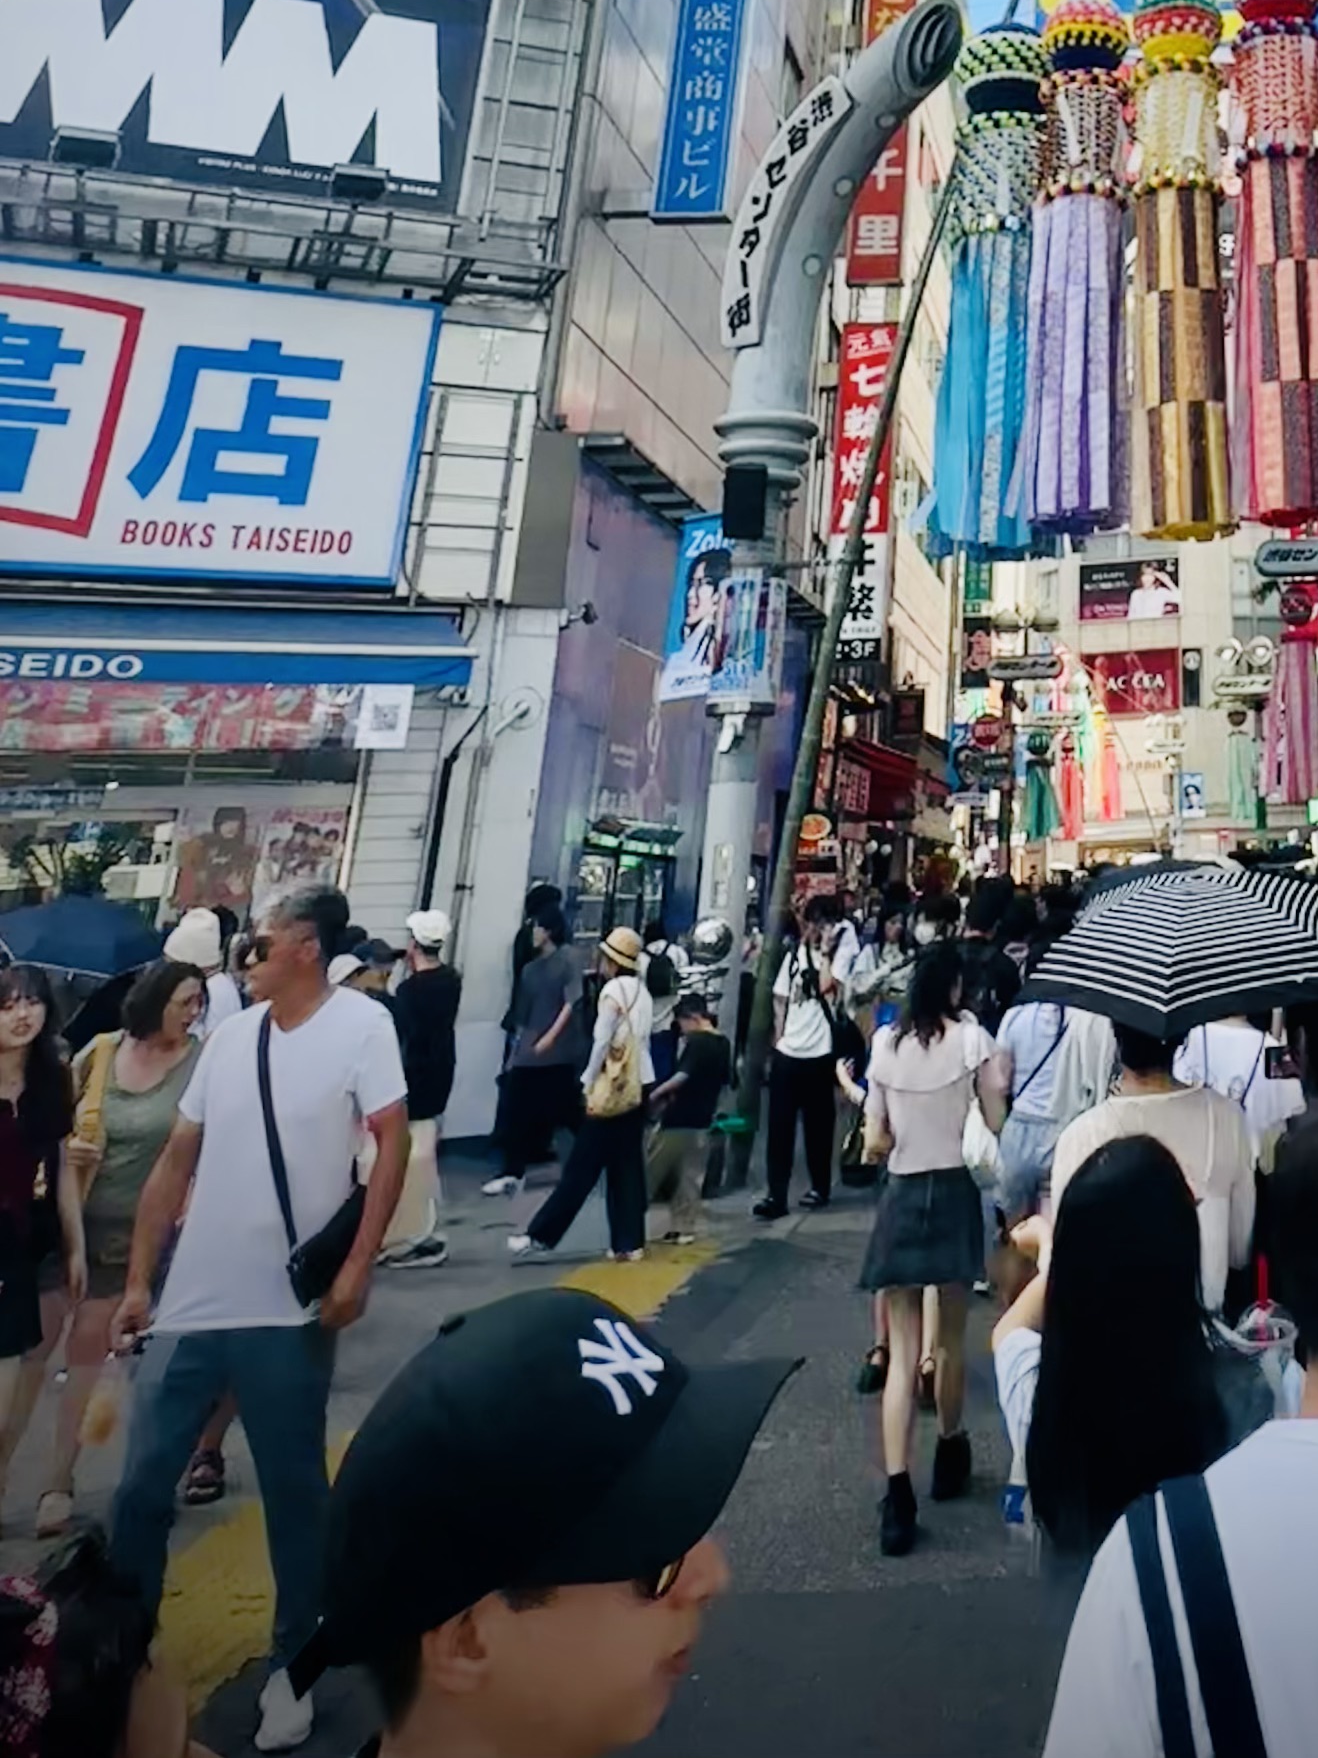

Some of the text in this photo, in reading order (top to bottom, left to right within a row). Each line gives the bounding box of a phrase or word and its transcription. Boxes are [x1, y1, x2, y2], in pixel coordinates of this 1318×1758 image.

[727, 90, 834, 338] 渋谷センター街
[120, 519, 354, 556] BOOKS TAISEIDO
[577, 1317, 665, 1416] NY
